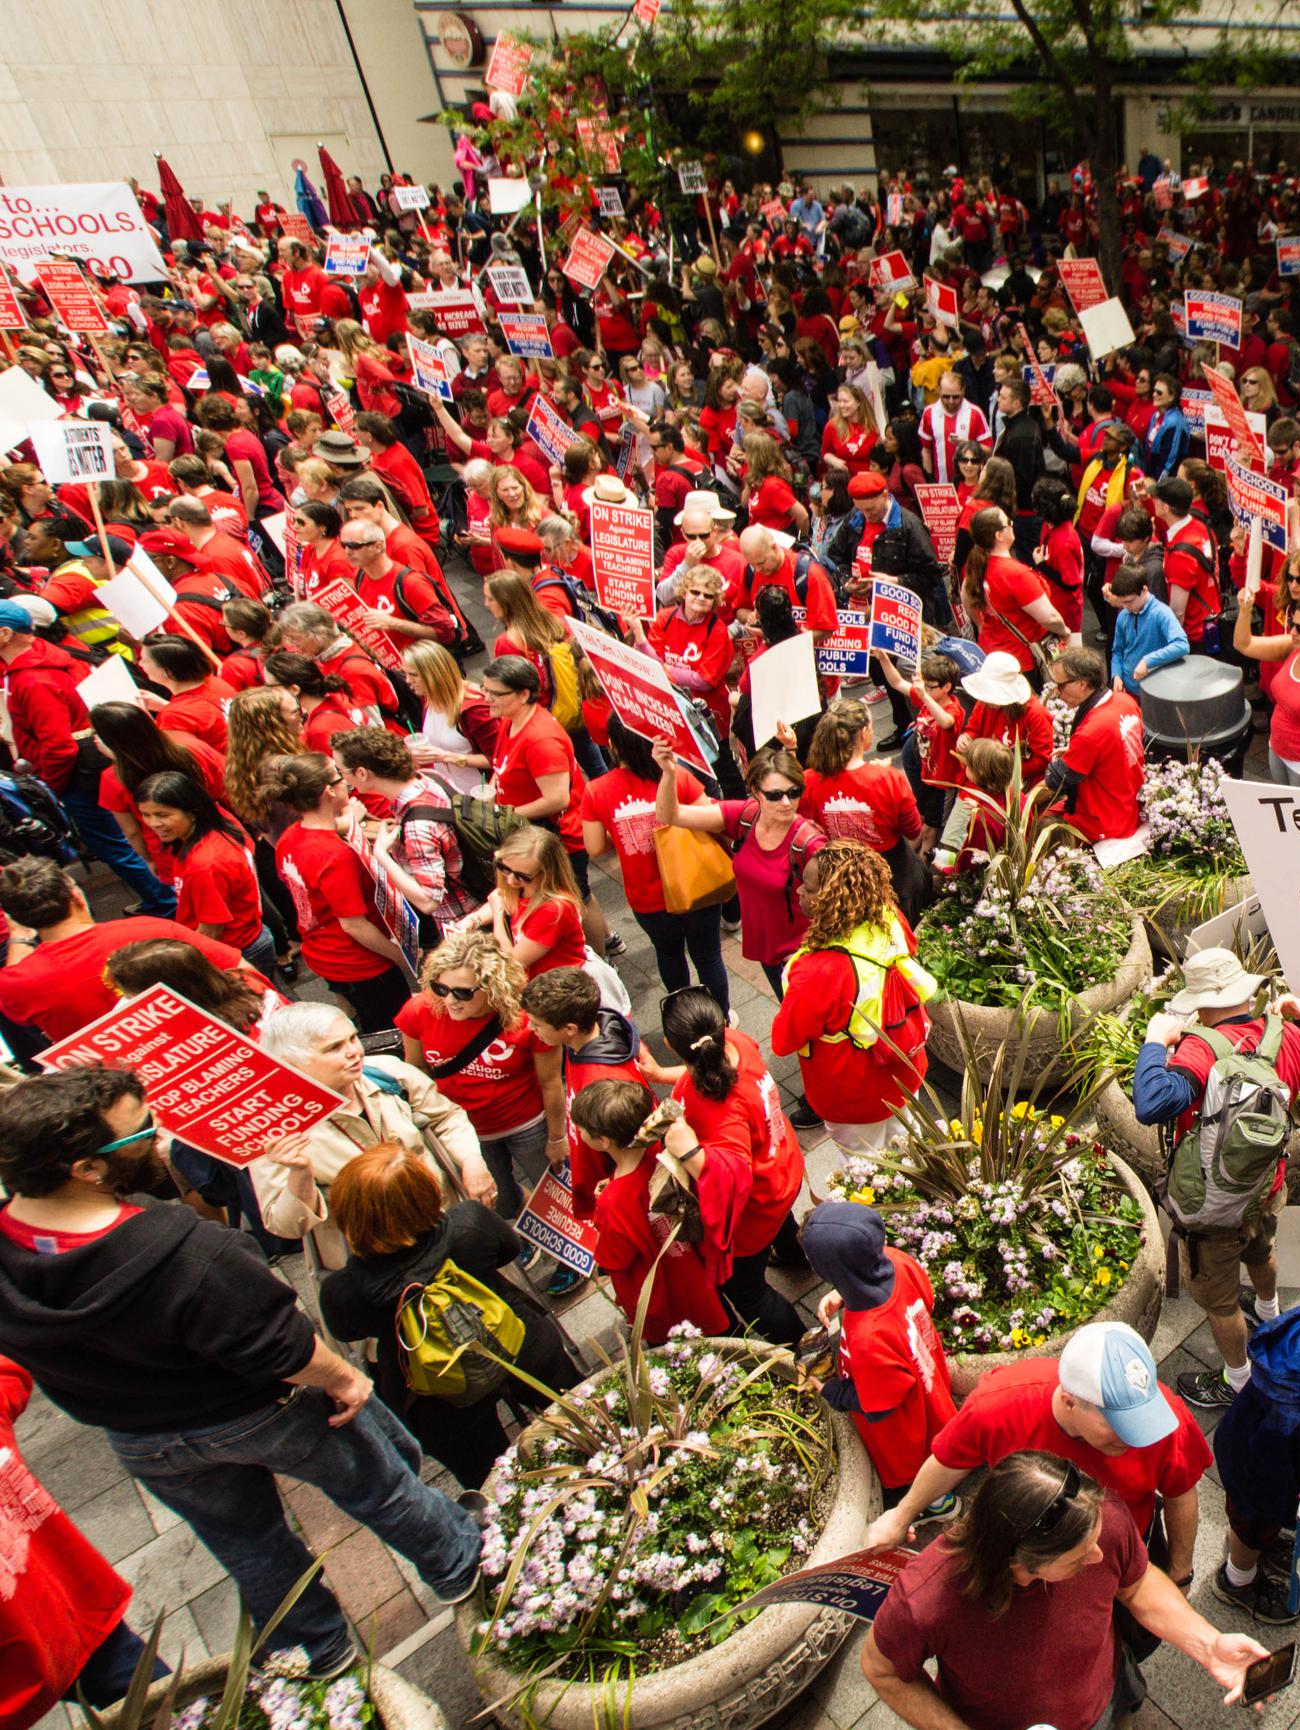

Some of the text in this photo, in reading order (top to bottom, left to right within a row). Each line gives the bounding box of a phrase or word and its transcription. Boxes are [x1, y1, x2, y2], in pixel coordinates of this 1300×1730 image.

[1209, 433, 1229, 446] DON'T
[1240, 470, 1283, 499] SCHOOLS
[593, 506, 650, 530] ON STRIKE
[1240, 495, 1281, 523] FUNDING
[594, 531, 650, 553] LEGISLATURE
[608, 524, 635, 536] Against
[595, 549, 651, 569] STOP BLAMING
[602, 559, 643, 577] TEACHERS
[604, 586, 645, 604] FUNDING
[608, 577, 638, 593] START
[880, 584, 910, 603] GOOD
[319, 585, 352, 610] STRIKE
[838, 614, 866, 625] OOLS
[880, 611, 910, 632] GOOD
[885, 627, 911, 645] FUND
[818, 661, 847, 673] OOLS
[819, 650, 856, 662] PUBLIC
[599, 669, 685, 729] DON'T INCREASE
[611, 690, 678, 739] CLASS SIZES!
[91, 995, 186, 1052] STRIKE
[119, 1032, 172, 1065] Against
[141, 1025, 227, 1084] ISLATURE
[184, 1046, 255, 1093] BLAMING
[171, 1066, 256, 1119] TEACHERS
[208, 1089, 273, 1133] START
[216, 1092, 304, 1147] FUNDING
[232, 1099, 324, 1158] SCHOOLS
[545, 1205, 585, 1241] REQUIRE
[522, 1215, 590, 1269] GOOD SCHOOLS
[830, 1598, 858, 1609] On
